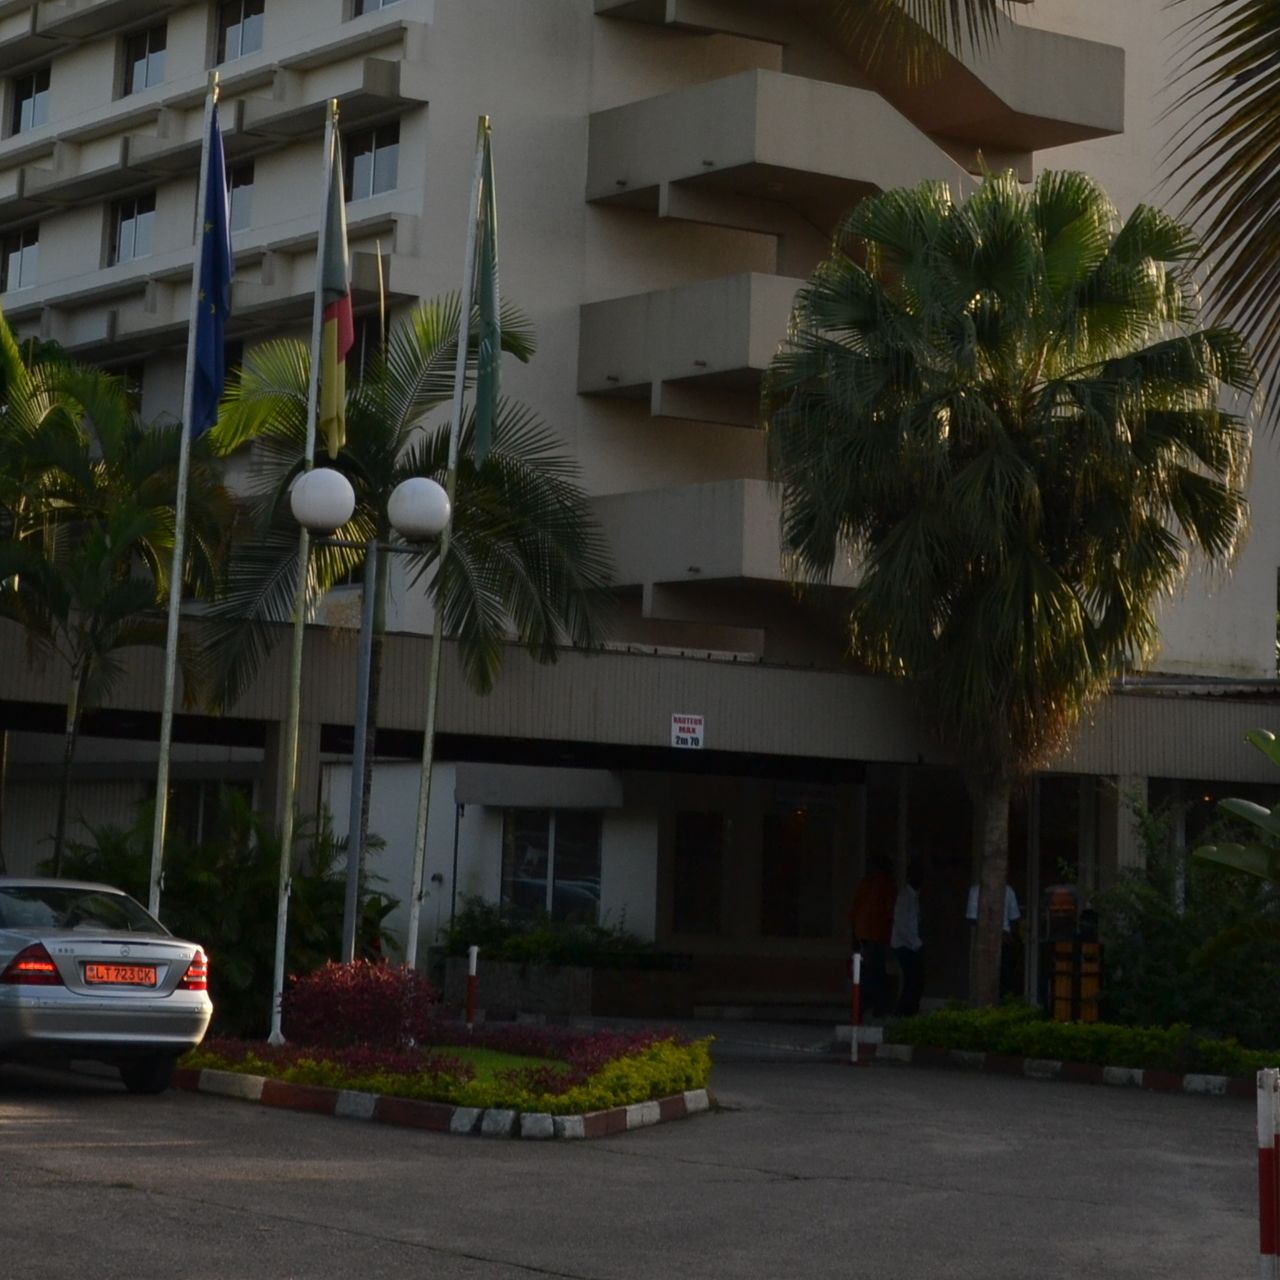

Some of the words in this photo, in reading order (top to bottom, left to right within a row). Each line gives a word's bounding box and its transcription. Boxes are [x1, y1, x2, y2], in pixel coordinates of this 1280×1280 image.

[675, 735, 689, 746] 2m
[690, 736, 700, 747] 70
[95, 966, 111, 980] LT
[114, 967, 135, 981] 723
